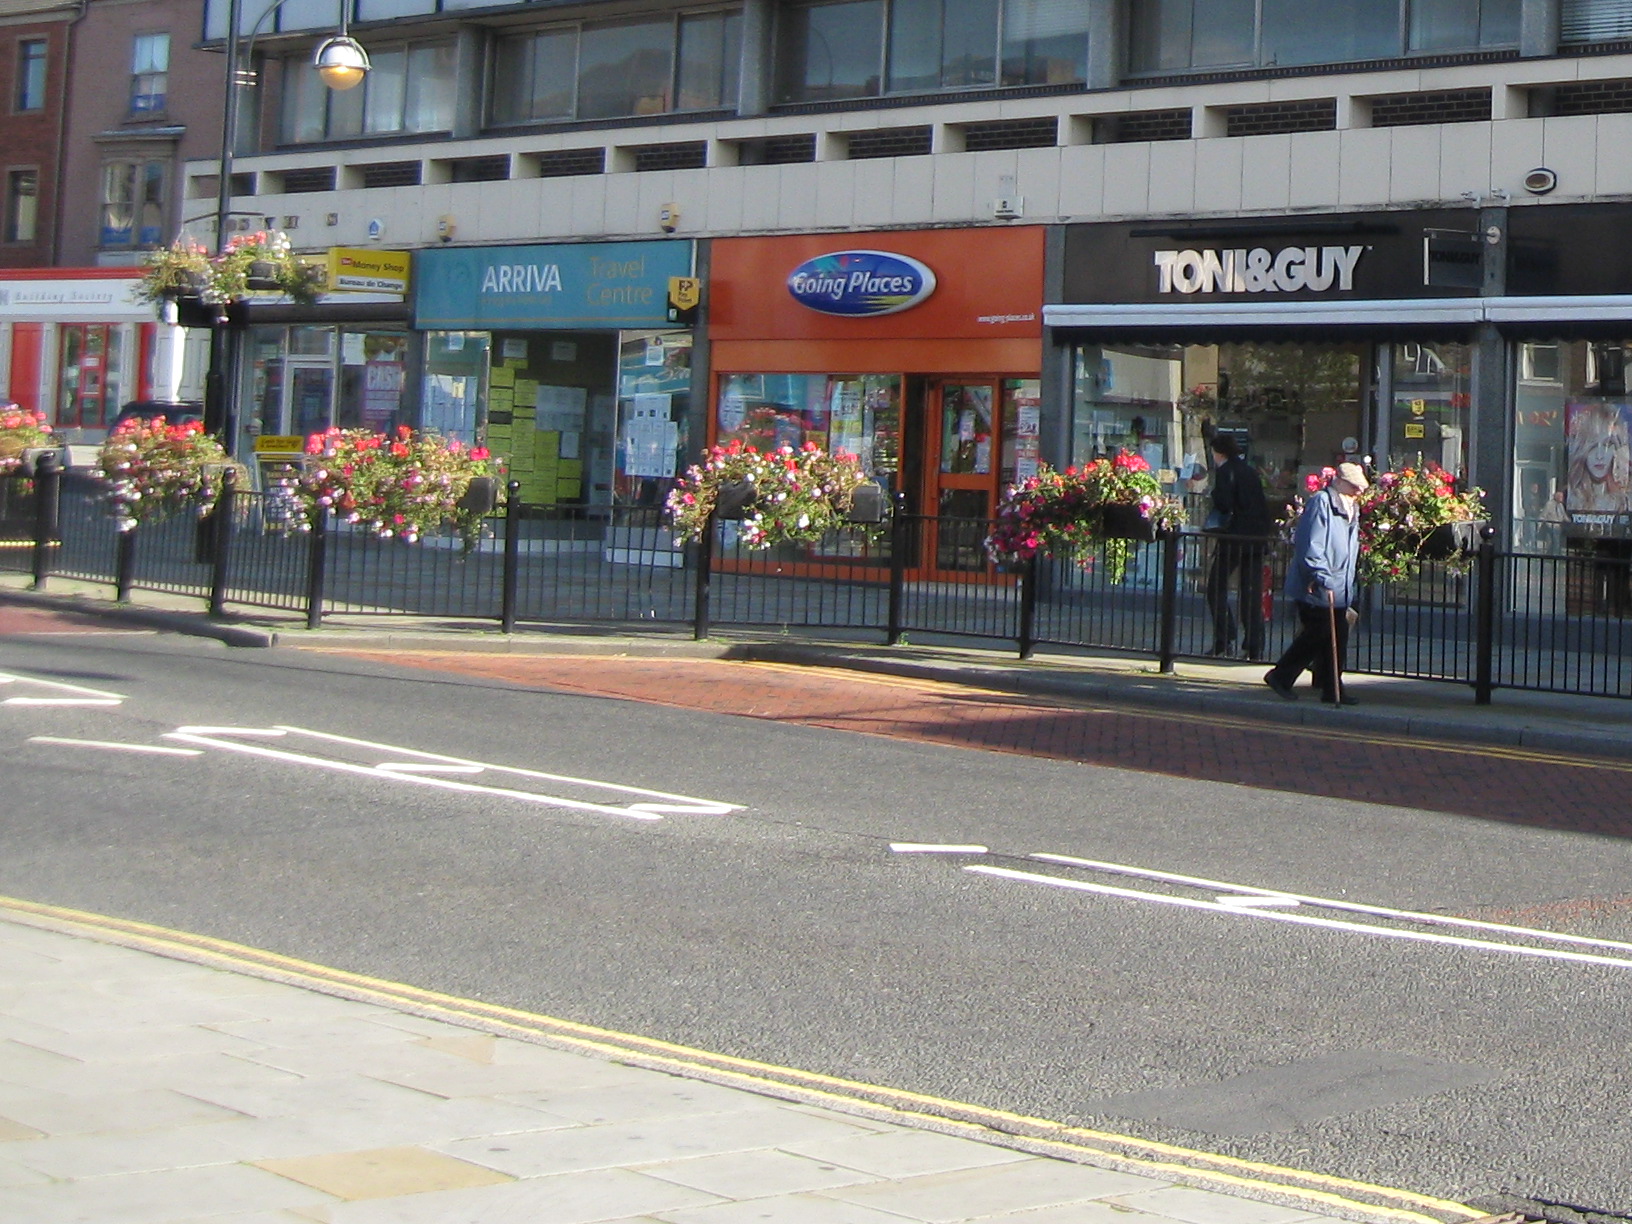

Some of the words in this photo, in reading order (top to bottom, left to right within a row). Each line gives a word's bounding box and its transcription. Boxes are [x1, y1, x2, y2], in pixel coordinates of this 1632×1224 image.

[481, 264, 562, 293] ARRIVA
[590, 255, 645, 278] Travel
[1155, 245, 1363, 294] TONI&GUY
[587, 283, 653, 306] Centre
[793, 272, 845, 300] Going
[848, 271, 914, 293] Places
